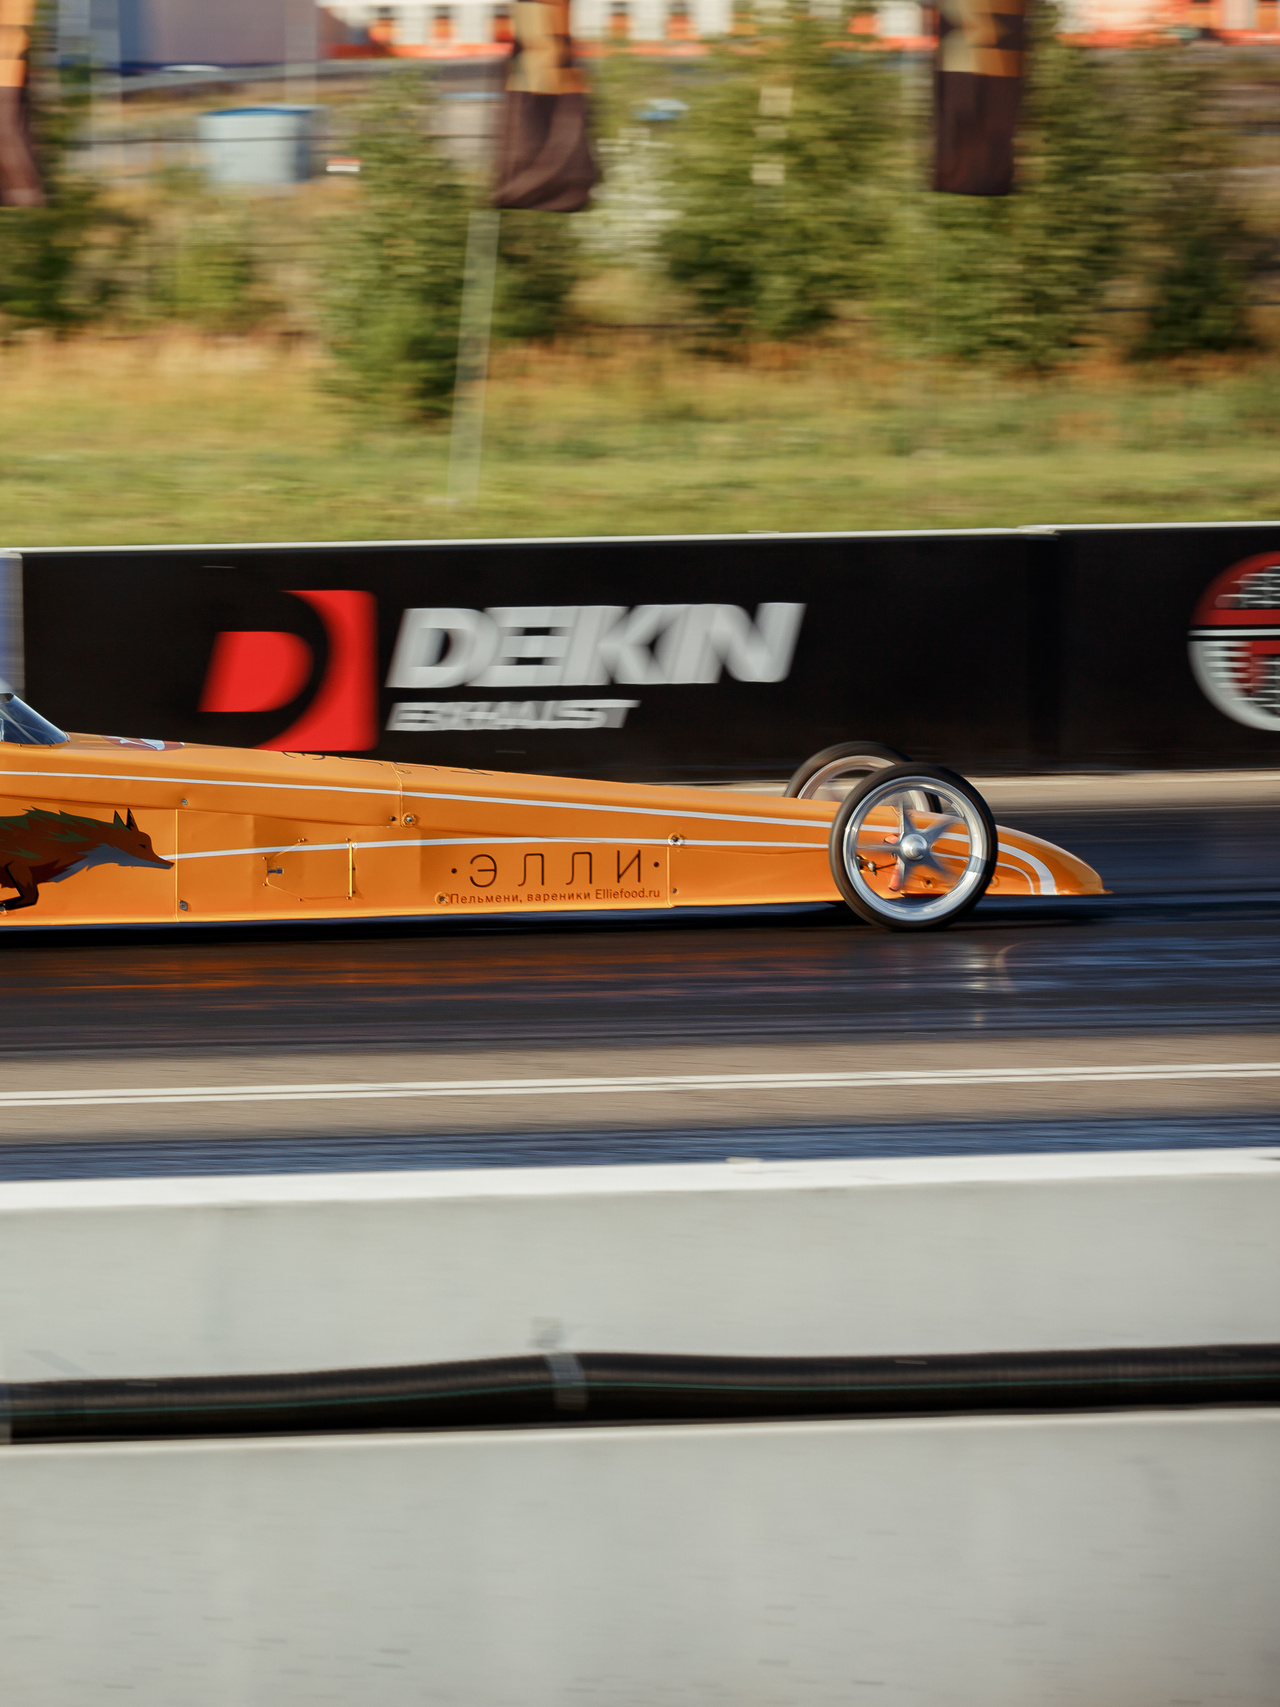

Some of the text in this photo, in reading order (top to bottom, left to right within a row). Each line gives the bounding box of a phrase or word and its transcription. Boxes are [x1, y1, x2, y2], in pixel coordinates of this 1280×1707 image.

[385, 699, 641, 731] EXHAUST
[469, 849, 642, 888] ЭЛЛИ
[449, 888, 660, 904] Пельмени, вареники Elliefood.ru
